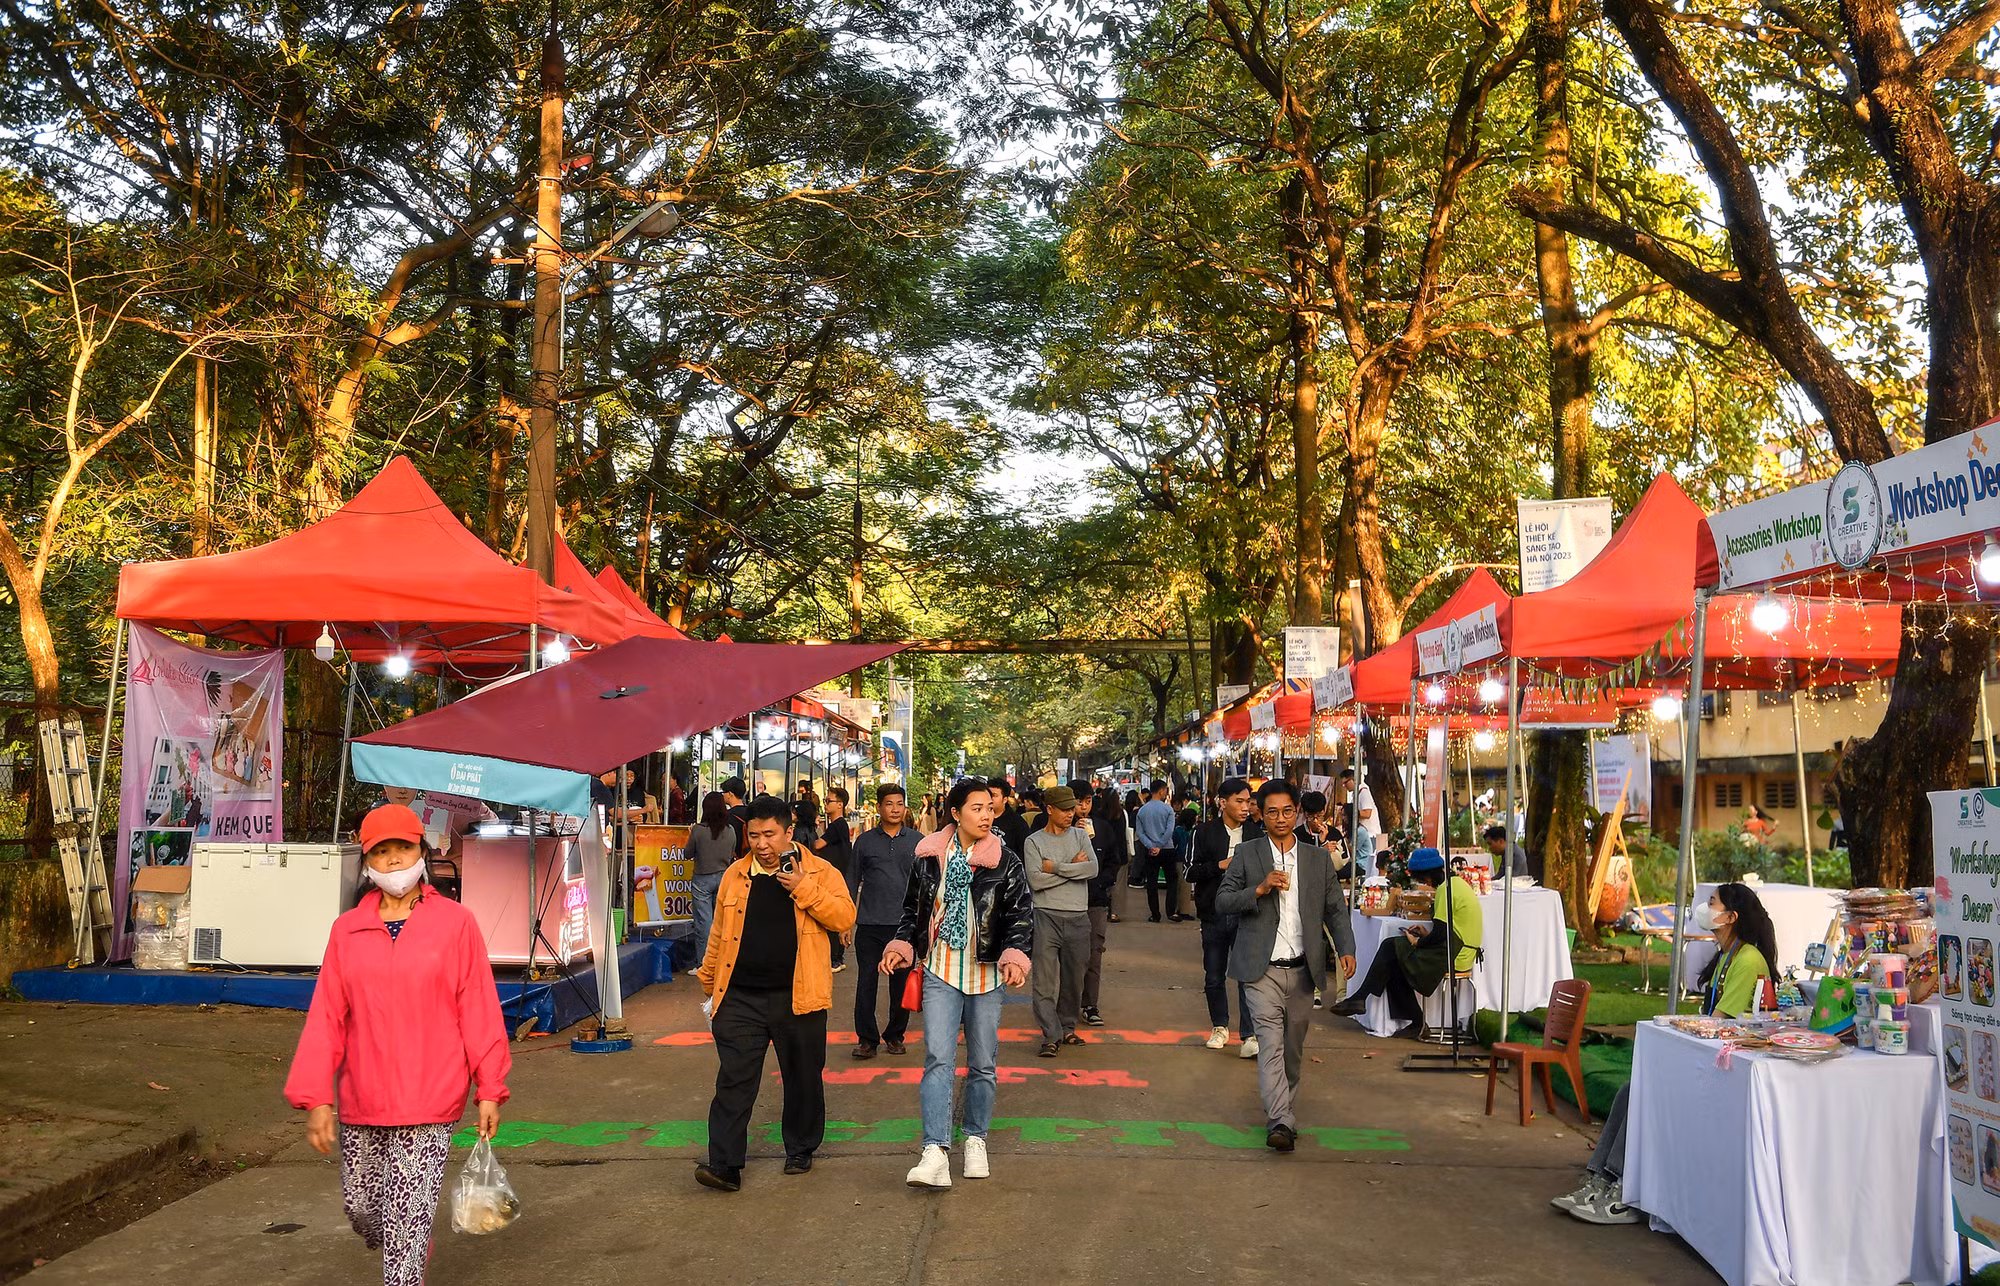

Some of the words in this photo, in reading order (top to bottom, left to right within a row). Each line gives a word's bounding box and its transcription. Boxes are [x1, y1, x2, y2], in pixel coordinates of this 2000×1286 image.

[1888, 471, 1969, 523] Workshop
[1725, 524, 1773, 558] Accessories
[1772, 511, 1822, 545] Workshop
[1837, 521, 1868, 537] CREATIVE
[1553, 551, 1572, 560] 2023
[215, 816, 240, 837] KEM
[242, 815, 273, 839] QUE
[661, 844, 692, 861] BÁN
[672, 864, 684, 876] 10
[664, 880, 692, 893] WON
[664, 895, 693, 916] 30k
[1961, 893, 1994, 923] Decor
